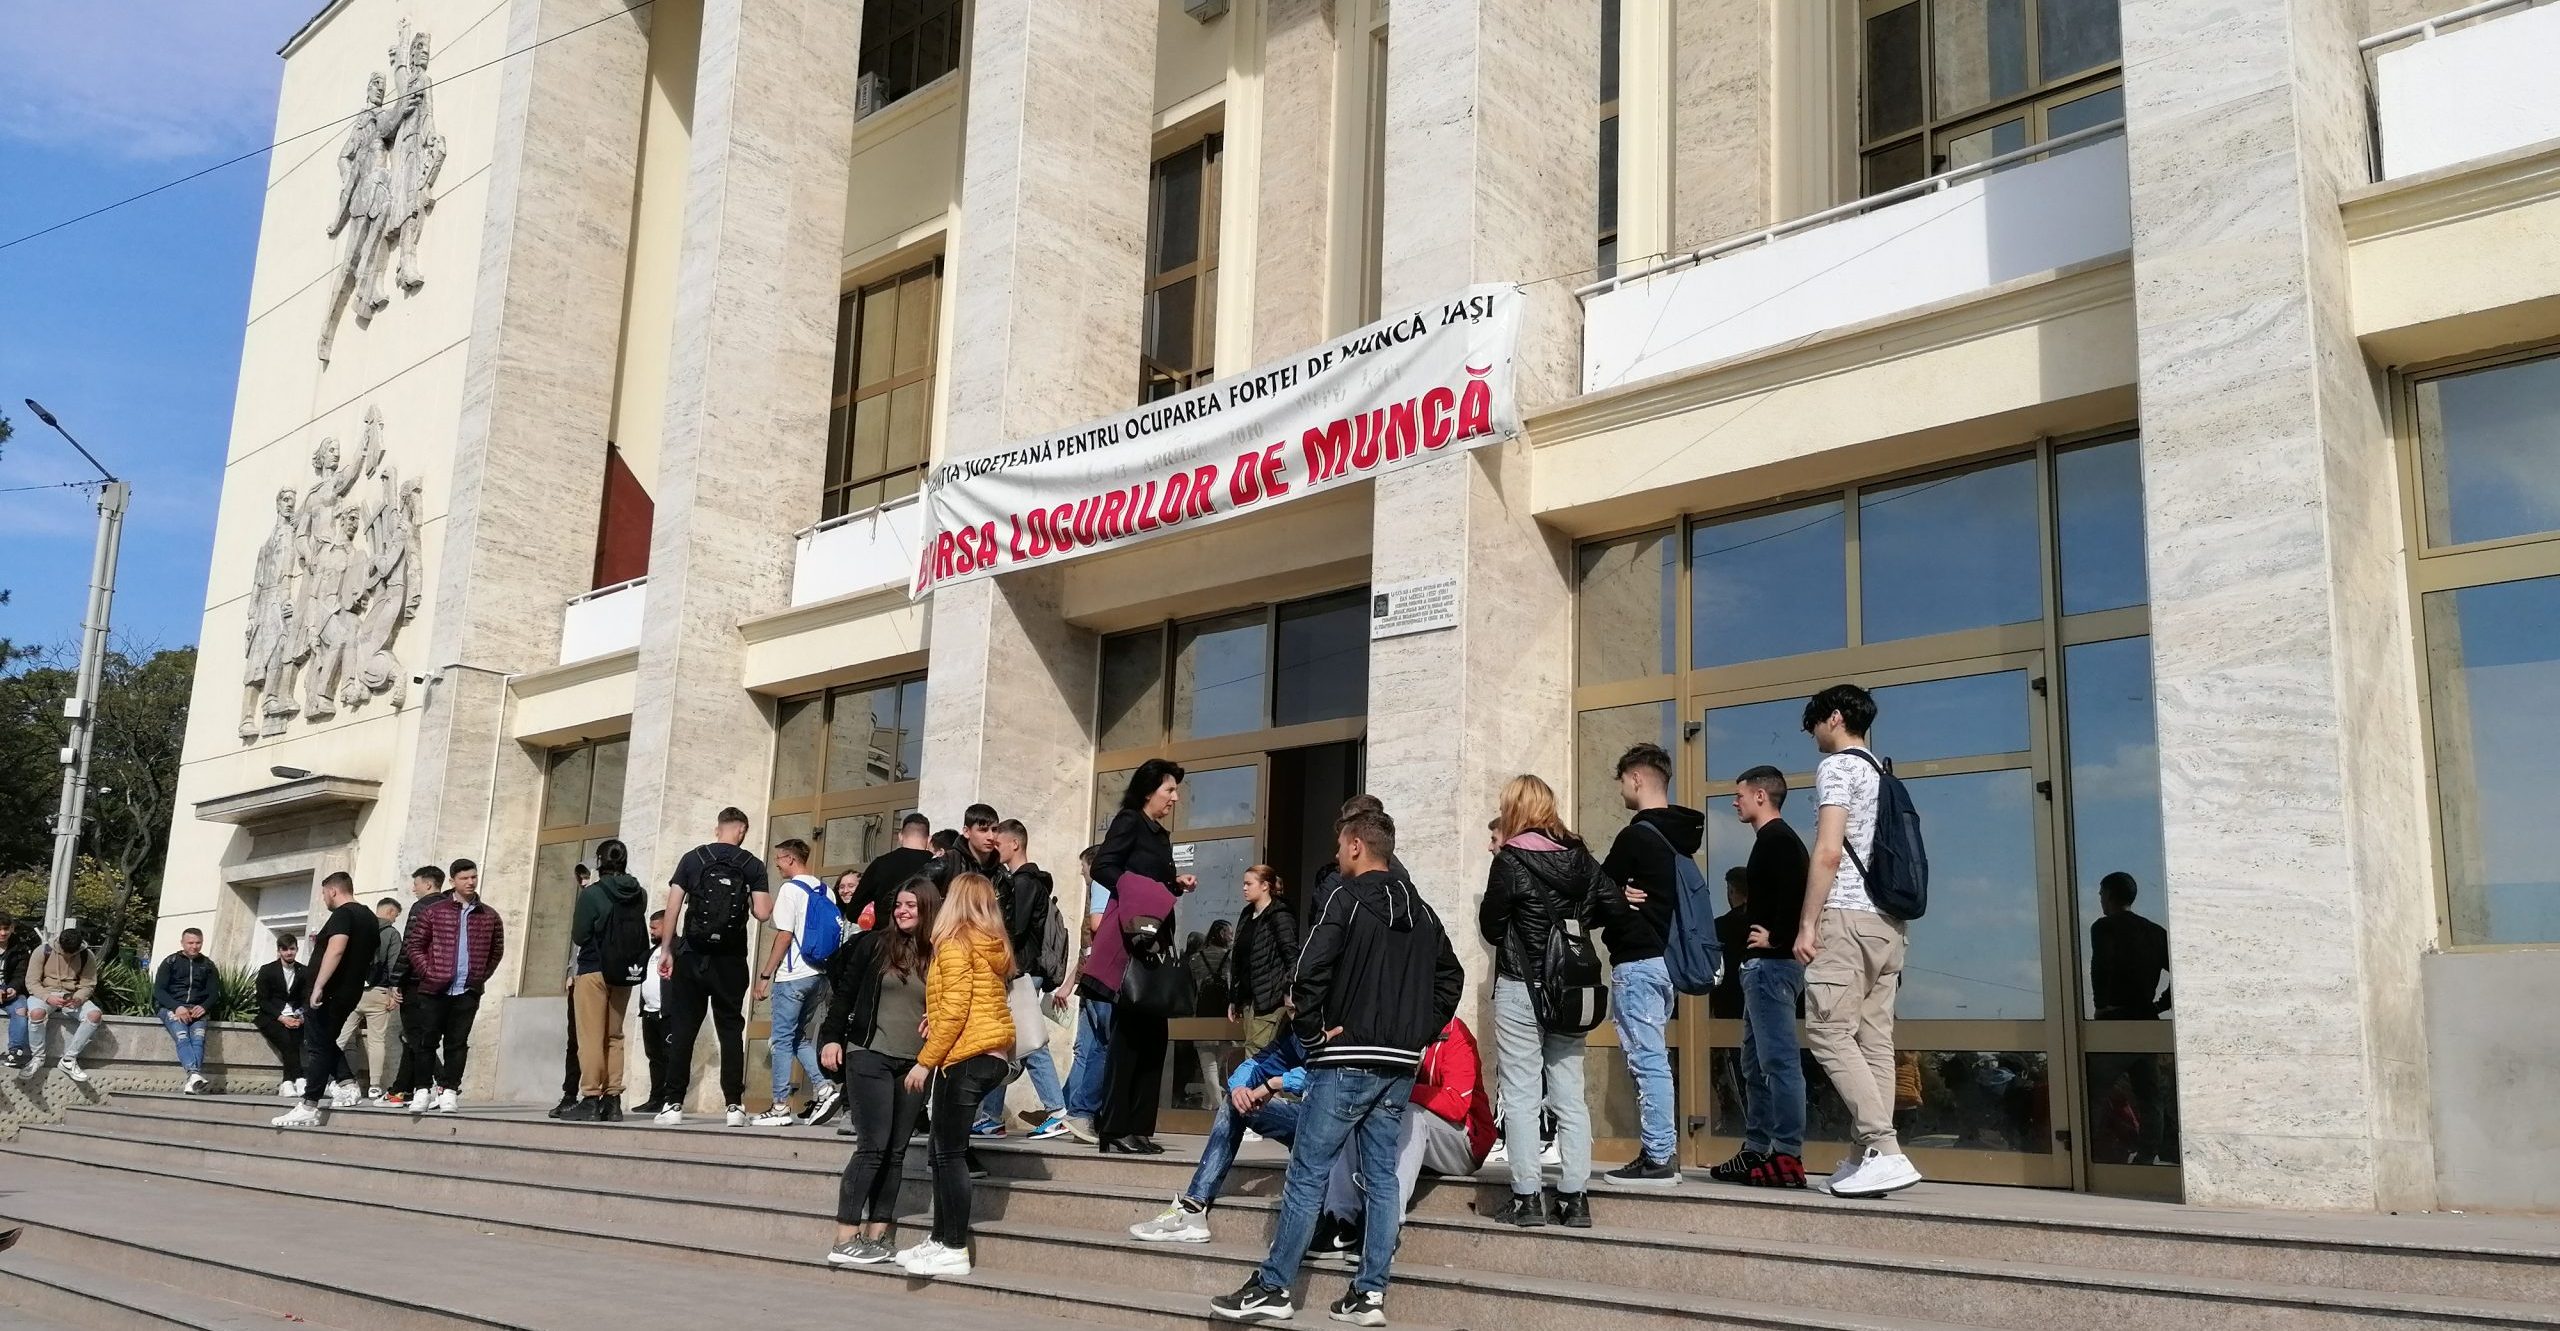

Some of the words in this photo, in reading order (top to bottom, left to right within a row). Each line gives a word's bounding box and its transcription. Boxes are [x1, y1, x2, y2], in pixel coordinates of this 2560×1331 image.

[1010, 464, 1219, 564] LOCURILOR
[1229, 440, 1291, 508] DE
[1302, 363, 1495, 484] MUNCĂ
[1057, 424, 1120, 459] PENTRU
[1126, 393, 1221, 439] OCUPAREA
[1229, 365, 1298, 407] FORȚEI
[1308, 351, 1333, 379] DE
[1340, 311, 1427, 363] MUNCĂ
